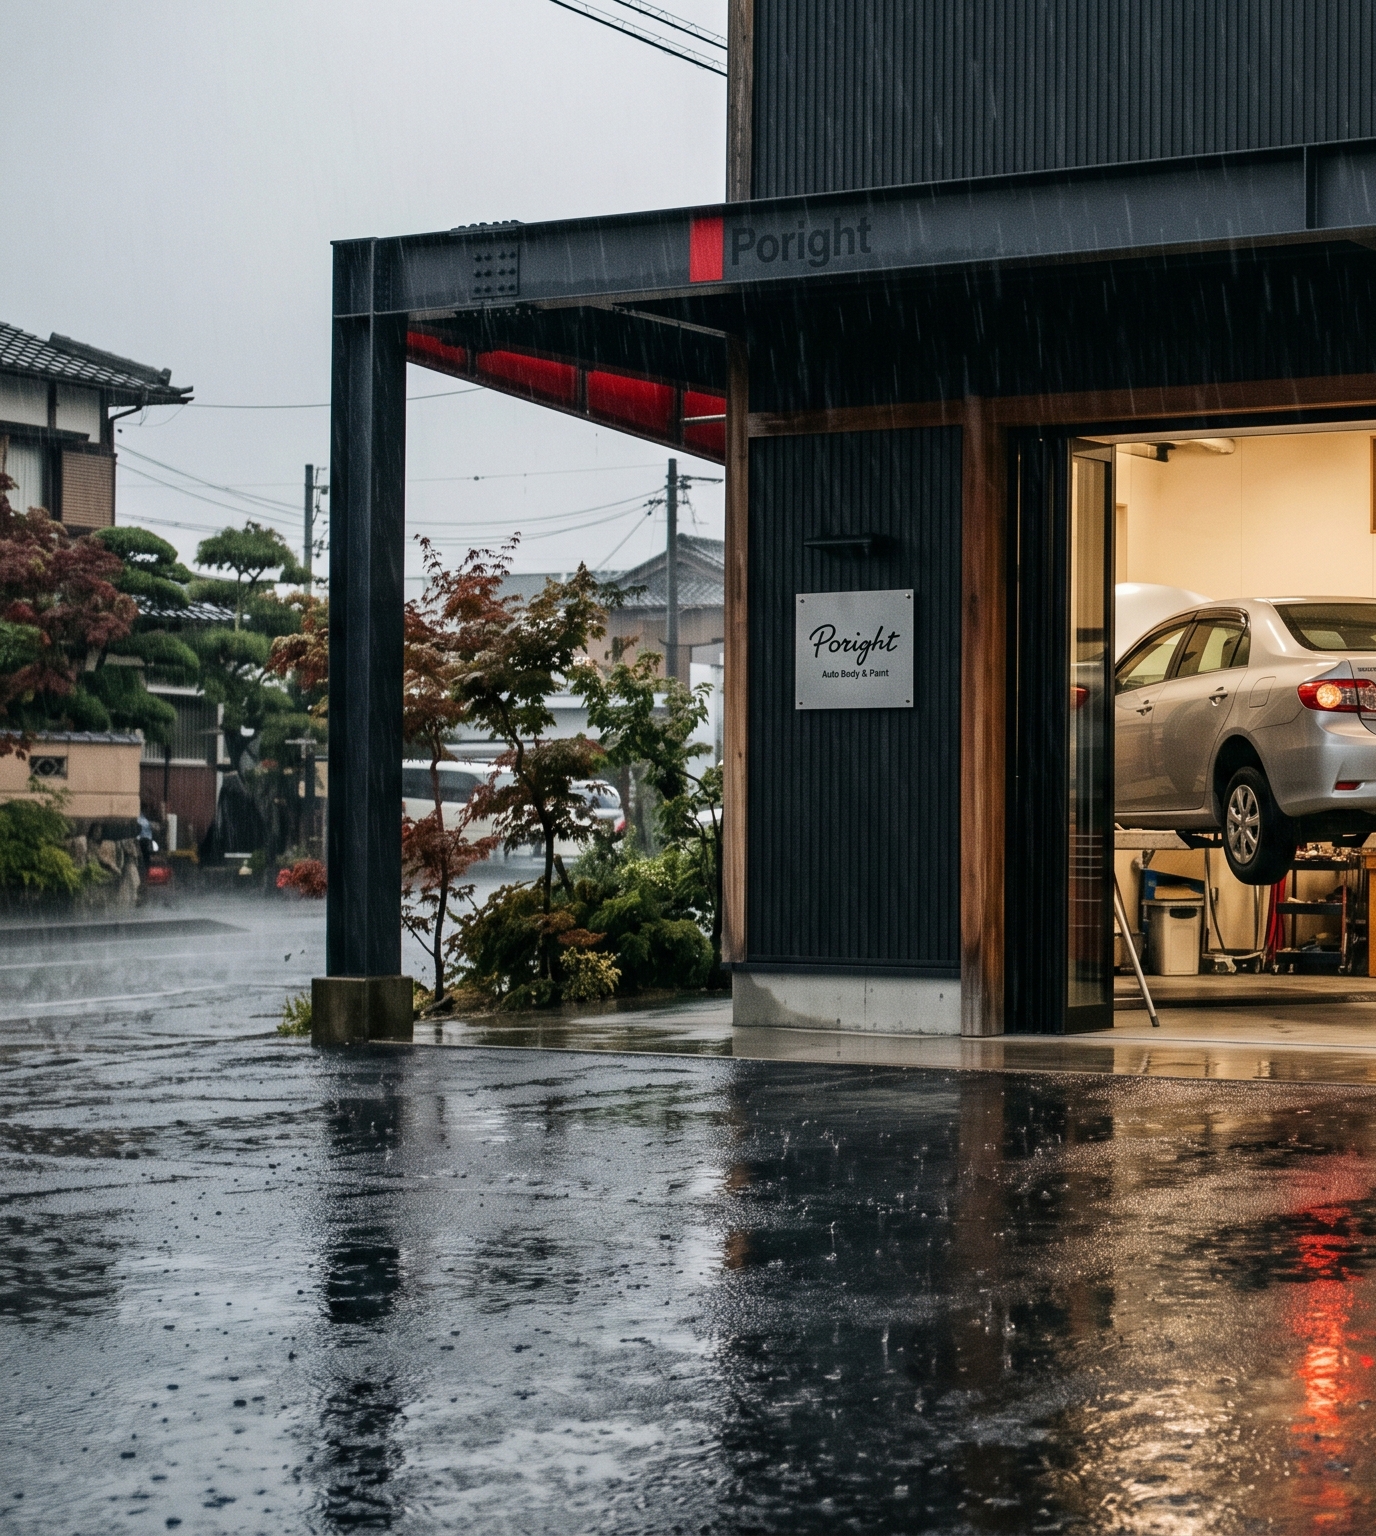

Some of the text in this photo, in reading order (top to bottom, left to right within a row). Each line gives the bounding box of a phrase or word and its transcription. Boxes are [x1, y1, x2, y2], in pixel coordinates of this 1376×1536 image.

[731, 216, 872, 268] Poright
[808, 624, 901, 666] Poright
[822, 669, 889, 680] Auto Body & Paint
